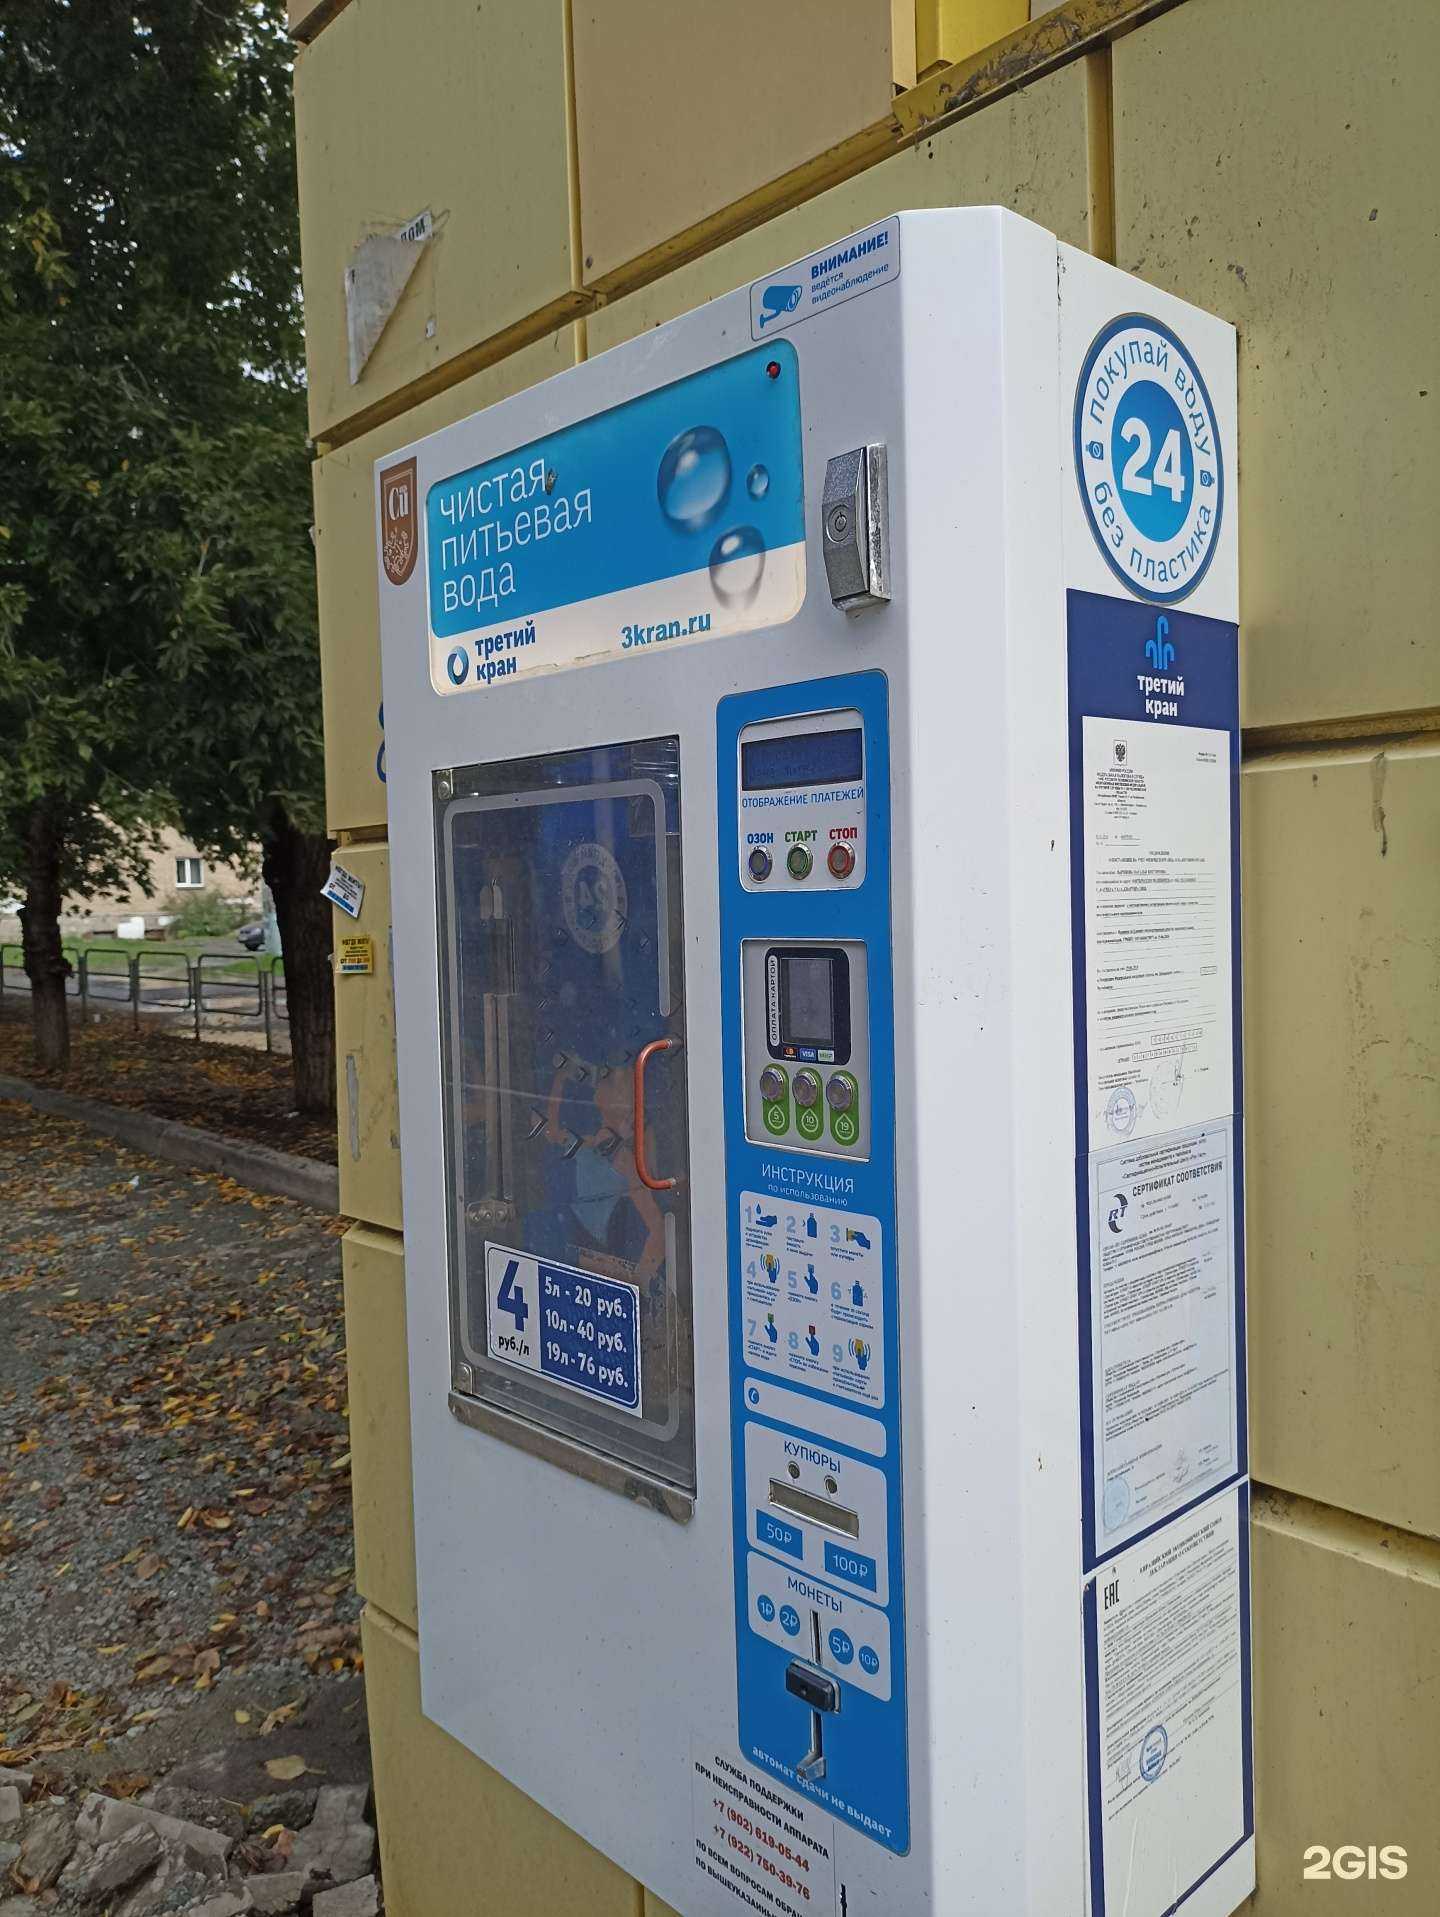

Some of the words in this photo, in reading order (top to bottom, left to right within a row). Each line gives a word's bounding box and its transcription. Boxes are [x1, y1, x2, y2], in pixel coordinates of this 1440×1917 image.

[811, 231, 889, 280] ВНИМАНИЕ!
[811, 263, 889, 304] видеонаблюдение
[1090, 339, 1169, 425] покупай
[1174, 368, 1211, 456] воду
[1120, 416, 1185, 503] 24
[440, 458, 546, 525] чистая
[1094, 480, 1124, 549] без
[442, 488, 592, 571] питьевая
[1130, 504, 1212, 583] пластика
[443, 562, 517, 612] вода
[474, 620, 536, 660] третий
[621, 613, 711, 649] 3kran.ru
[476, 656, 517, 684] кран
[1137, 674, 1185, 697] третий
[1145, 699, 1178, 719] кран
[742, 794, 809, 809] ОТОБРАЖЕНИЕ
[811, 786, 865, 805] ПЛАТЕЖЕЙ
[747, 832, 774, 844] ОЗОН
[784, 829, 818, 843] СТАРТ
[829, 827, 858, 840] СТОП
[771, 1000, 779, 1041] ОПЛАТА
[802, 1050, 815, 1059] VISA
[773, 1111, 780, 1120] 5
[805, 1115, 815, 1124] 10
[840, 1121, 850, 1131] 19
[762, 1163, 855, 1193] ИНСТРУКЦИЯ
[1132, 1175, 1175, 1197] СЕРТИФИКАТ
[1176, 1160, 1223, 1184] СООТВЕТСТВИЯ
[768, 1184, 778, 1193] по
[779, 1186, 848, 1206] использованию
[745, 1206, 753, 1224] 1
[786, 1215, 796, 1233] 2
[830, 1224, 841, 1243] 3
[747, 1261, 757, 1279] 4
[787, 1270, 797, 1289] 5
[497, 1259, 529, 1332] 4
[544, 1276, 561, 1298] 5л
[575, 1285, 592, 1307] 20
[597, 1297, 627, 1319] руб.
[830, 1281, 842, 1301] 6
[597, 1331, 627, 1353] руб.
[747, 1319, 757, 1337] 7
[788, 1331, 799, 1350] 8
[498, 1335, 530, 1356] руб./л
[832, 1344, 843, 1363] 9
[598, 1365, 629, 1388] руб.
[784, 1441, 841, 1474] КУПЮРЫ
[787, 1576, 843, 1614] МОНЕТЫ
[714, 1756, 748, 1785] СЛУЖБА
[749, 1778, 804, 1822] ПОДДЕРЖКИ
[752, 1746, 796, 1779] автомат
[796, 1774, 829, 1802] сдачи
[831, 1795, 845, 1811] не
[847, 1804, 892, 1838] выдает
[695, 1761, 711, 1778] ПРИ
[712, 1771, 782, 1828] НЕИСПРАВНОСТИ
[783, 1822, 829, 1860] АППАРАТА
[712, 1798, 725, 1813] +7
[727, 1806, 753, 1836] (902)
[713, 1824, 725, 1840] +7
[728, 1832, 754, 1863] (922)
[695, 1856, 706, 1870] ПО
[696, 1838, 707, 1853] ПО
[708, 1848, 729, 1869] ВСЕМ
[730, 1863, 774, 1903] ВОПРОСАМ
